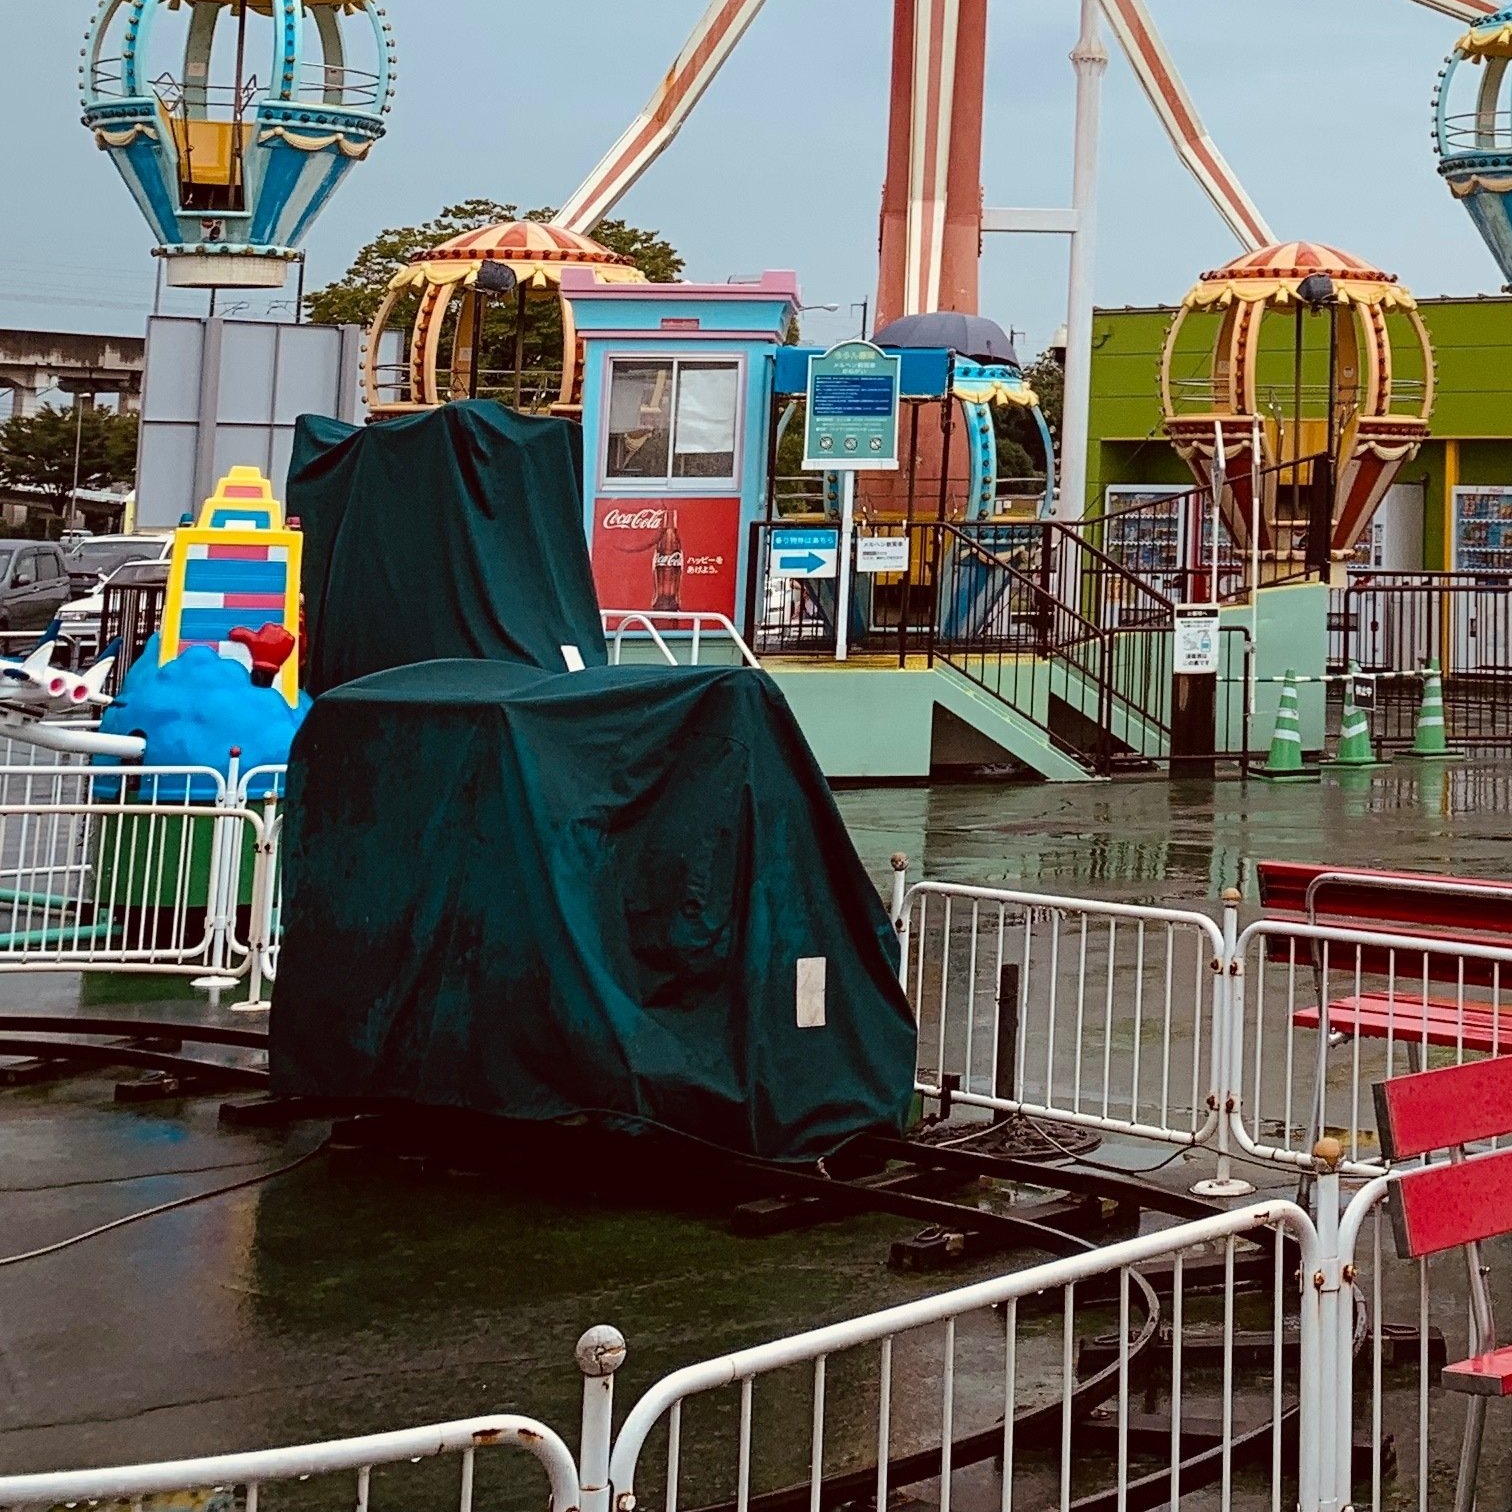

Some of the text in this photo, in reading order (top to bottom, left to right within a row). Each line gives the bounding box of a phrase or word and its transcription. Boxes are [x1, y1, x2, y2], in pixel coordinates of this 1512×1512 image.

[602, 508, 666, 529] Coca-Cola
[686, 556, 724, 565] ハッピーを
